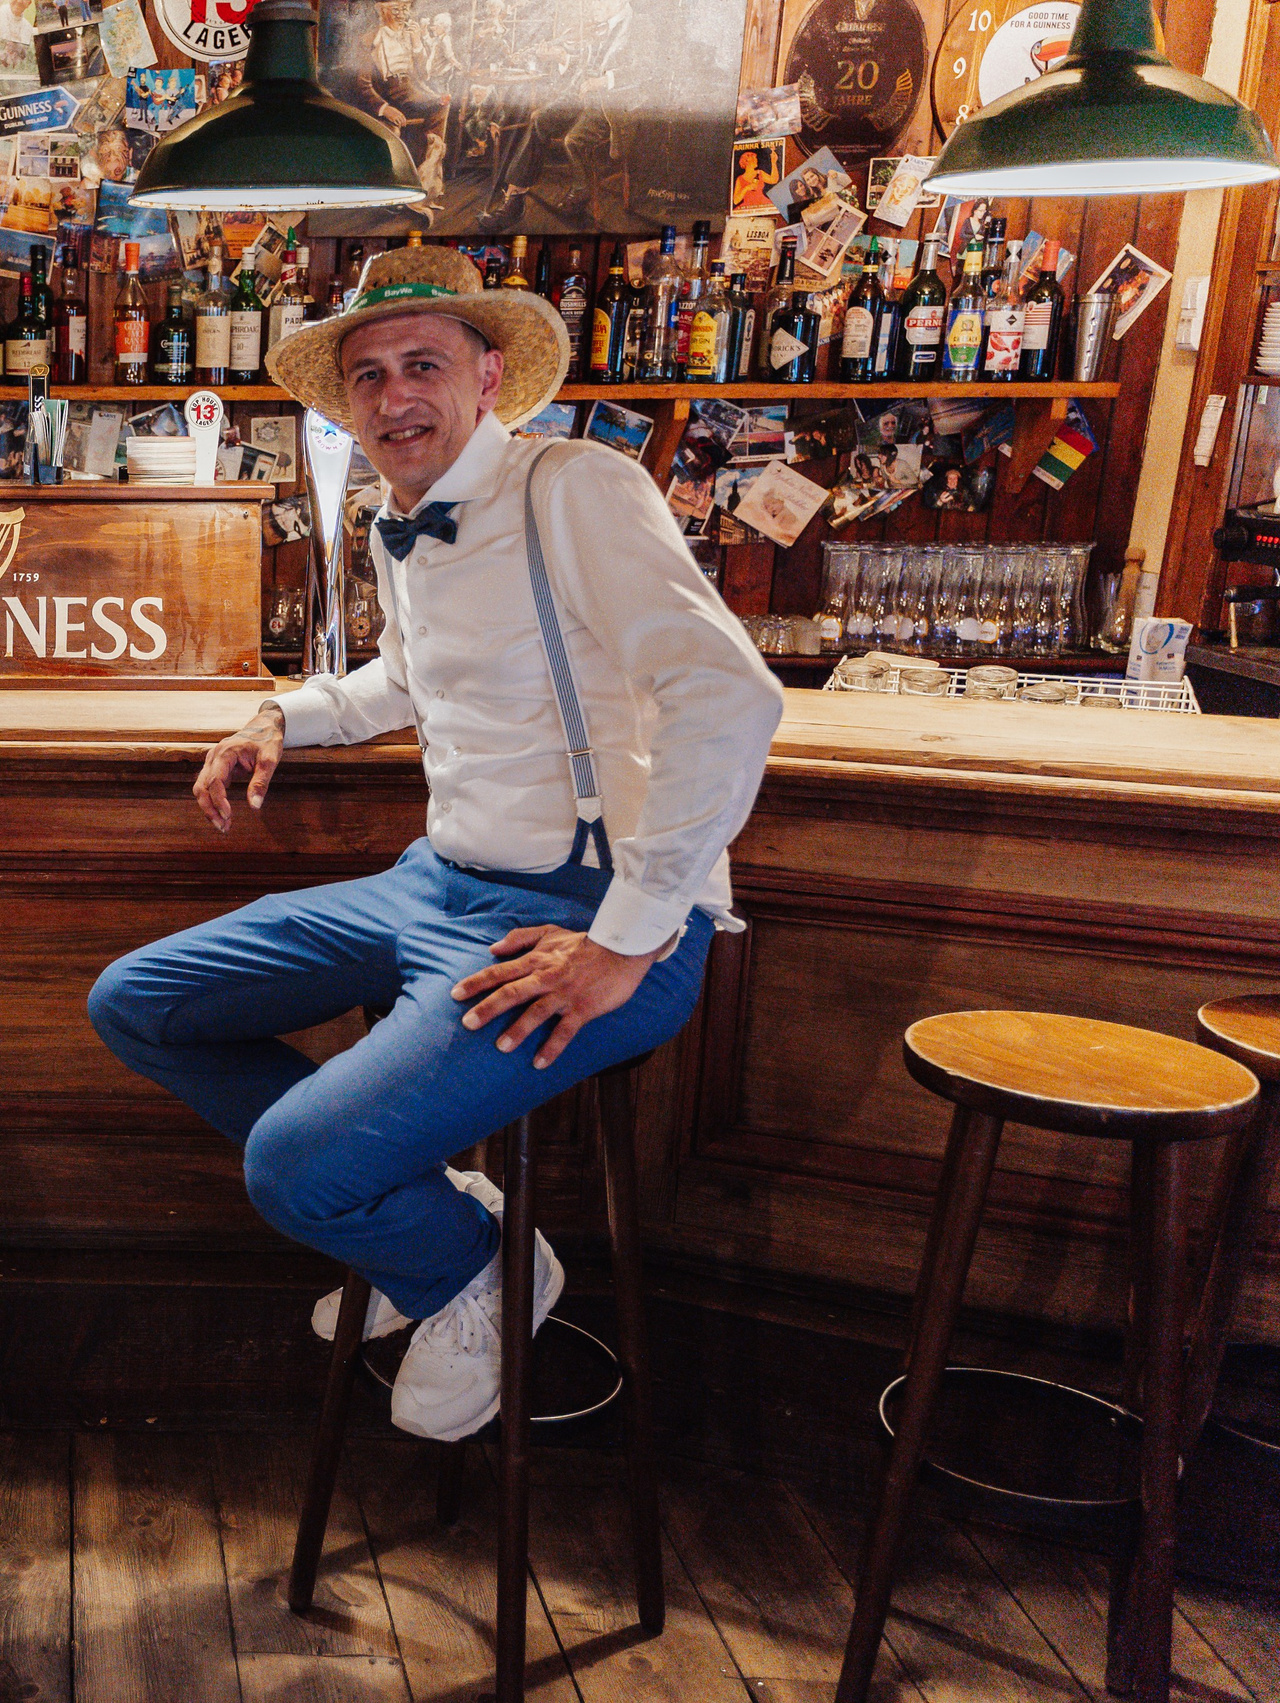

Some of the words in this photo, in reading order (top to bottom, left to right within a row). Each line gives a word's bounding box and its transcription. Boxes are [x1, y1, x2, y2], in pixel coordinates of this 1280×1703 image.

[968, 10, 992, 31] 10
[1028, 12, 1049, 20] GOOD
[1010, 20, 1024, 28] FOR
[1033, 21, 1071, 29] GUINNESS
[953, 57, 966, 79] 9
[834, 61, 880, 90] 20
[761, 140, 784, 149] SANTA
[746, 231, 769, 239] LISBOA
[384, 287, 413, 297] BayWa
[909, 319, 942, 327] PERN
[195, 405, 215, 420] 13
[13, 572, 40, 582] 1759
